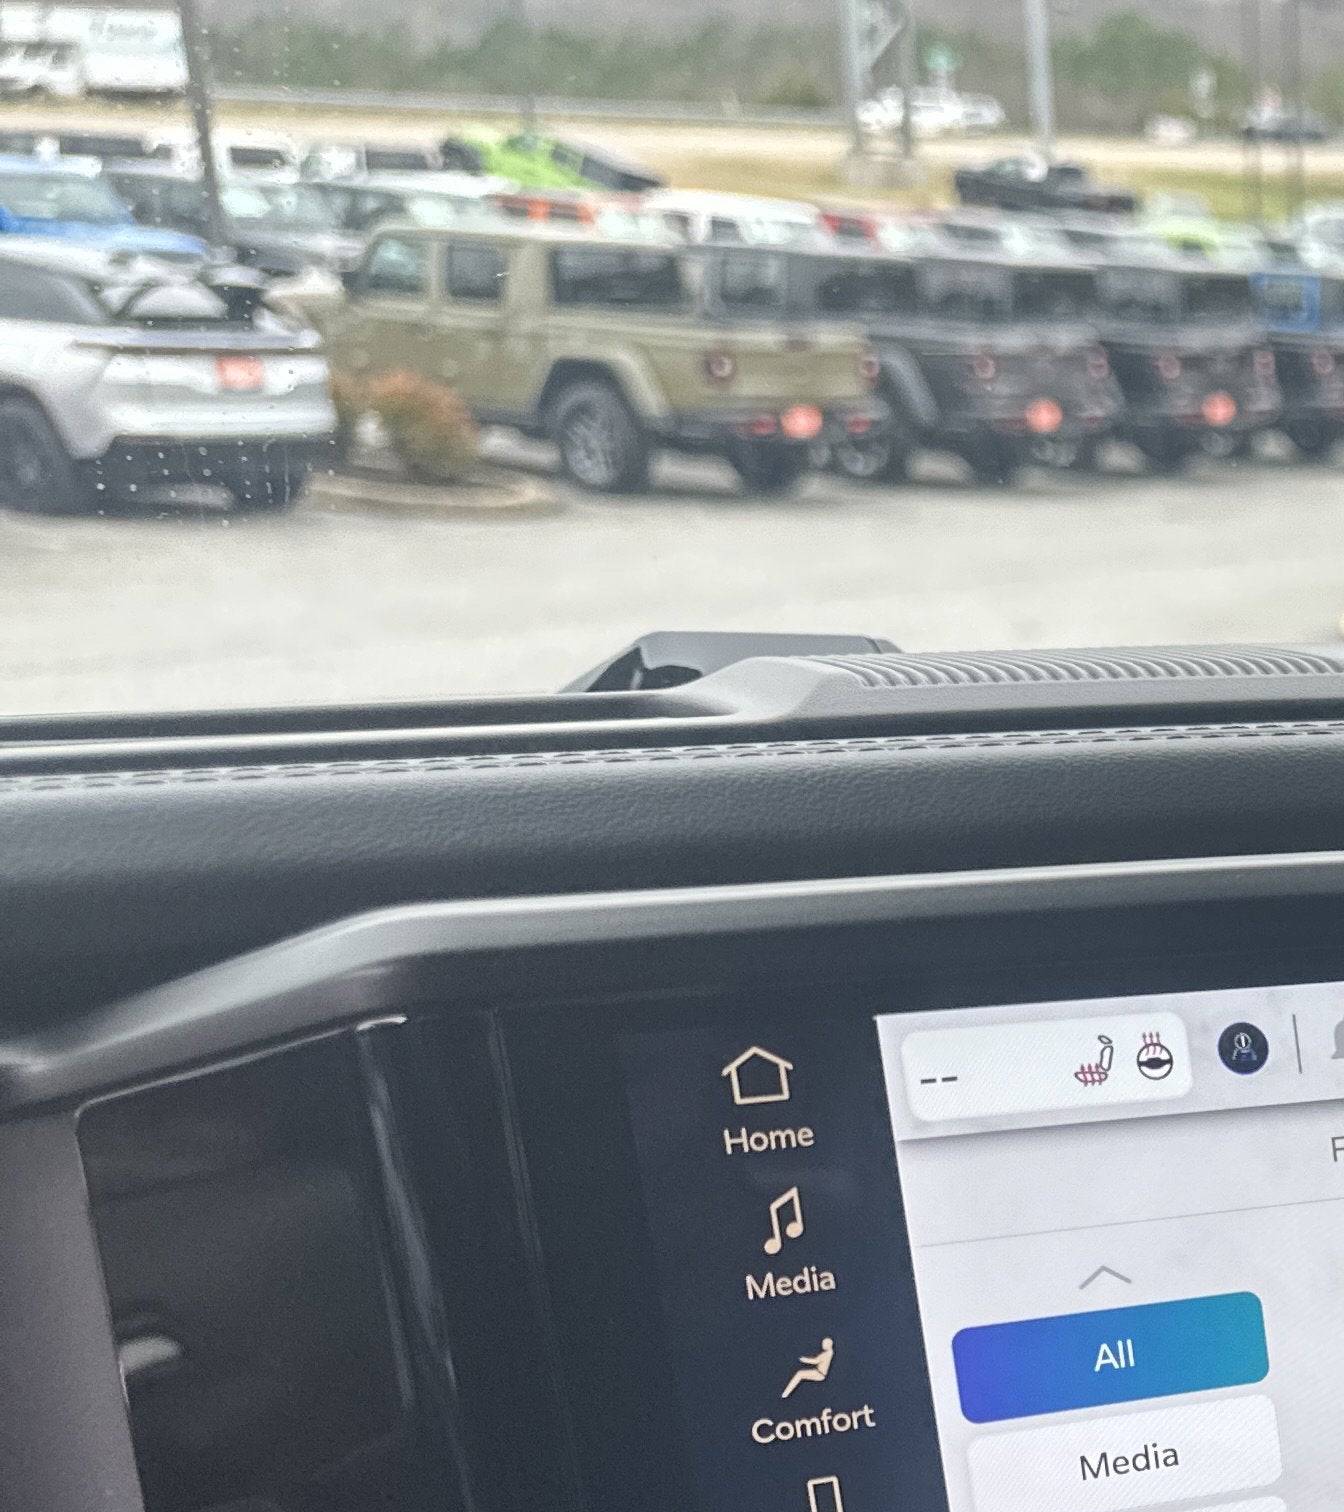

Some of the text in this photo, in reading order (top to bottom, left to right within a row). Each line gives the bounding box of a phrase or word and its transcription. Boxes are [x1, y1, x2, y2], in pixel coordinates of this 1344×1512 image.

[723, 1125, 815, 1155] Home
[745, 1265, 837, 1300] Media
[1094, 1338, 1136, 1373] All
[751, 1403, 877, 1445] Comfort
[1079, 1442, 1180, 1482] Media
